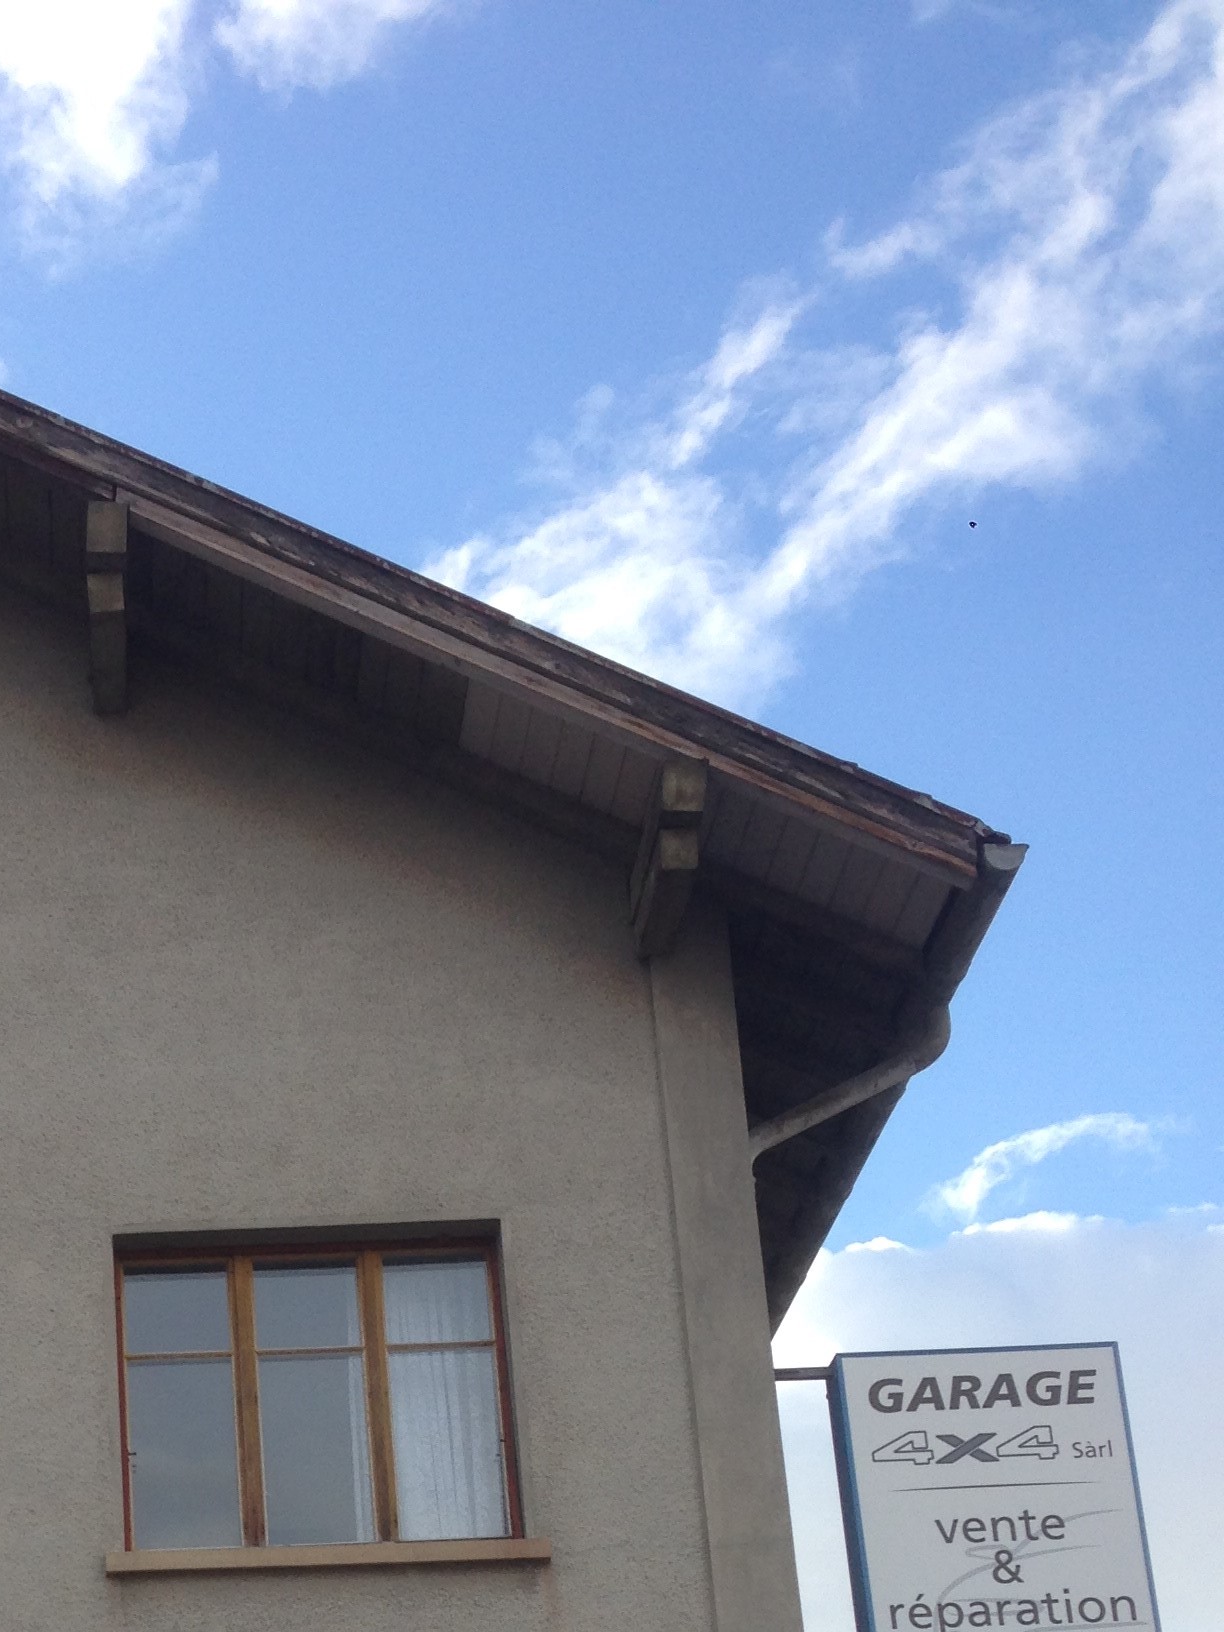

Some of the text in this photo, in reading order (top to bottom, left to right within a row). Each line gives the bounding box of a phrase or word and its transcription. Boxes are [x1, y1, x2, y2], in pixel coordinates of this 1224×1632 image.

[868, 1368, 1097, 1413] GARAGE
[1072, 1440, 1113, 1459] Sàrl
[934, 1509, 1065, 1544] vente
[992, 1549, 1025, 1584] &
